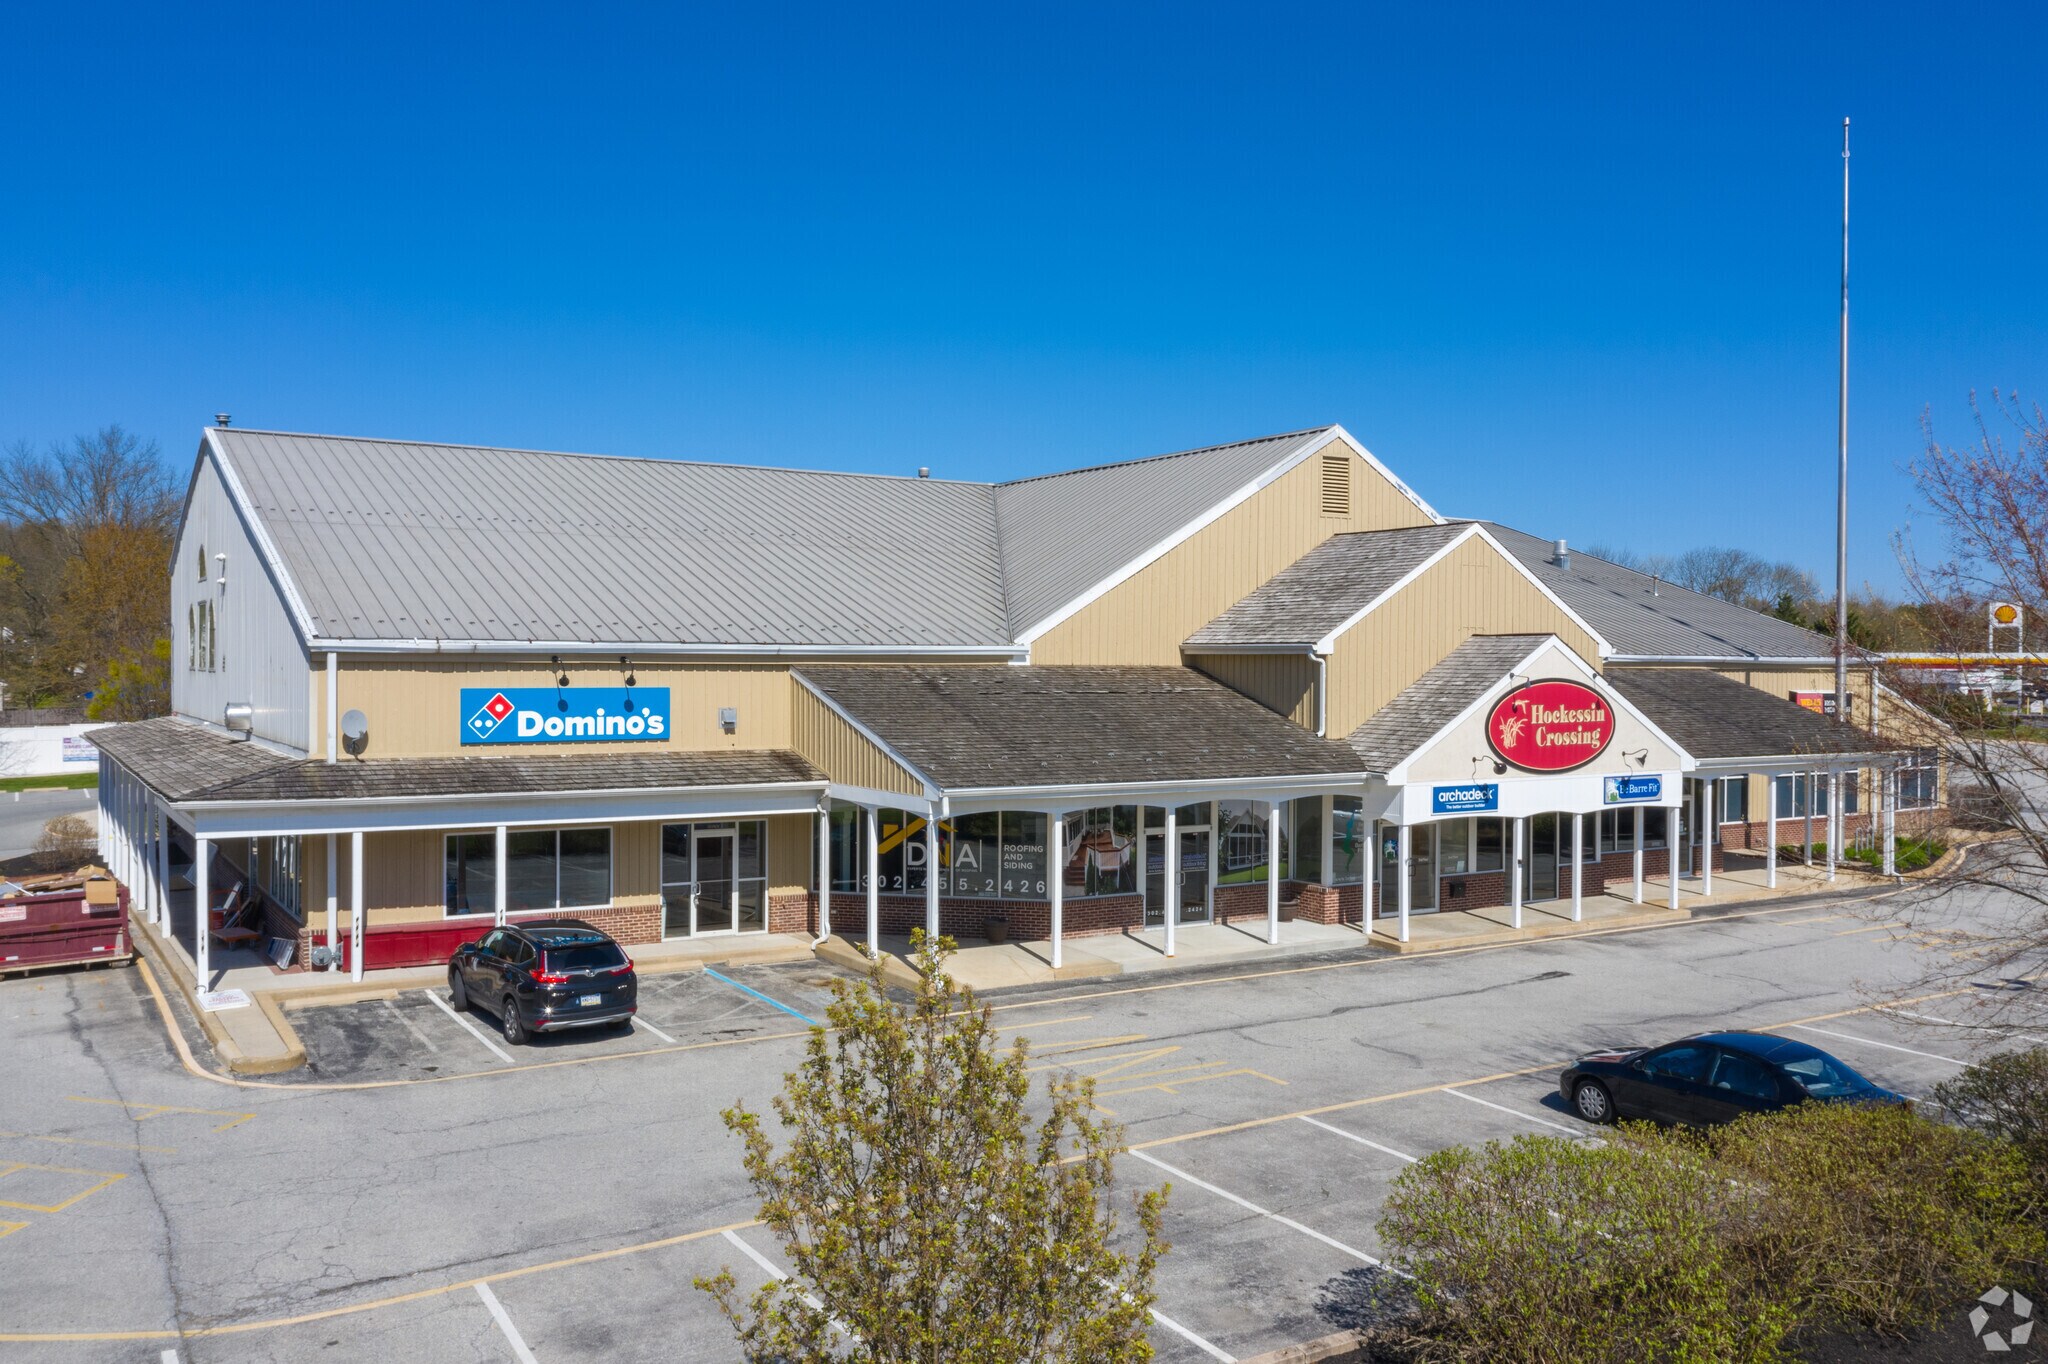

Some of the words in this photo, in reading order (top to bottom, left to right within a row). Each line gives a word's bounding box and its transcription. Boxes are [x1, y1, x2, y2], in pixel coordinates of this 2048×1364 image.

[1531, 703, 1605, 724] Hockessin
[517, 707, 665, 737] Domino's
[1535, 725, 1601, 748] Crossing
[1630, 783, 1648, 794] Barre
[1649, 782, 1658, 792] Fit
[1438, 788, 1493, 802] archadeck
[1004, 844, 1044, 853] ROOFING
[1004, 853, 1023, 861] AND
[1004, 861, 1033, 870] SIDING
